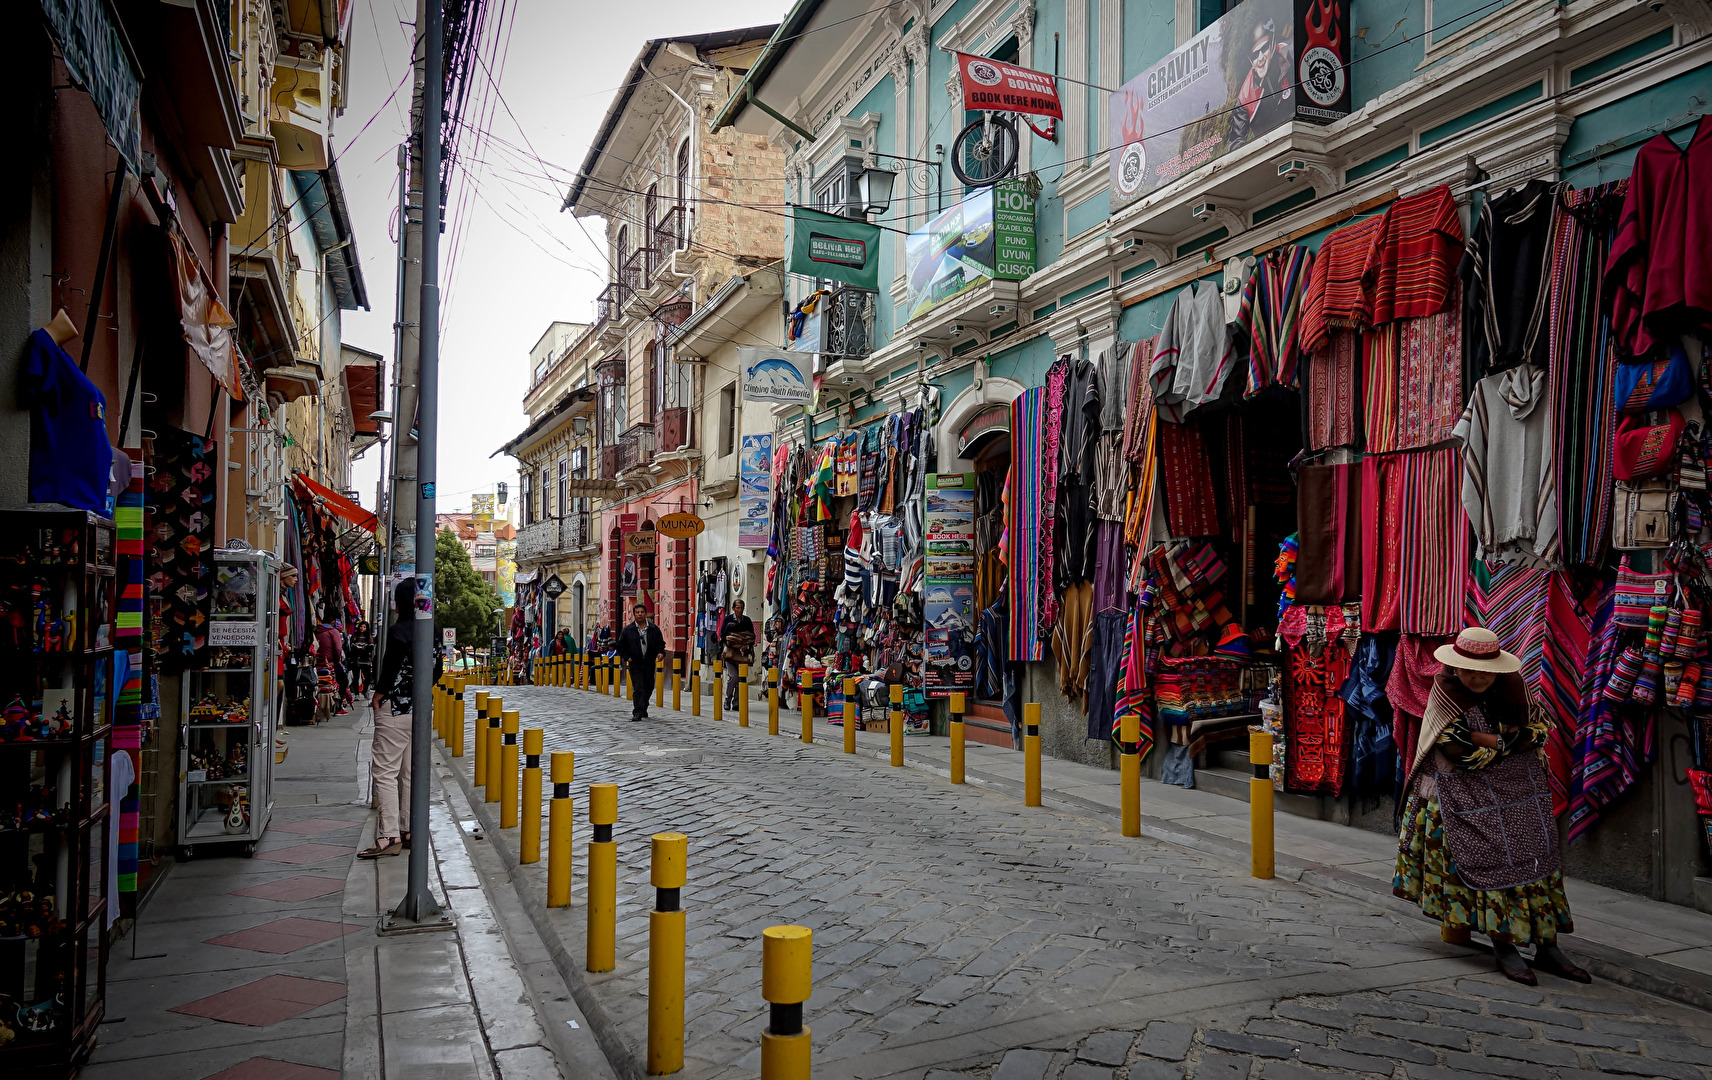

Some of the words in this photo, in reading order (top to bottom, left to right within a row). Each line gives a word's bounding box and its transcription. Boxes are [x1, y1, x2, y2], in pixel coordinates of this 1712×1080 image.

[1147, 34, 1210, 99] GRAVITY
[1002, 67, 1050, 85] GRAVITY
[1007, 77, 1055, 97] BOLIVIA
[1148, 91, 1169, 110] ASSISTED
[1168, 77, 1192, 98] MOUNTAIN
[1192, 65, 1209, 82] BIKING
[971, 92, 1000, 103] BOOK
[1003, 94, 1028, 107] HERE
[1030, 98, 1058, 112] NOW!
[1155, 153, 1182, 176] GALERIA
[1183, 132, 1223, 161] ARTESANAL
[997, 191, 1035, 211] HOP
[997, 223, 1010, 231] ISLA
[1011, 224, 1022, 232] DEL
[1023, 225, 1034, 233] SOL
[812, 241, 843, 252] BOLIVIA
[844, 244, 862, 254] HOP
[1005, 236, 1028, 246] PUNO
[1002, 249, 1031, 260] UYUNI
[997, 263, 1035, 276] CUSCO
[743, 384, 770, 394] Climbing
[770, 386, 787, 396] South
[973, 408, 1009, 430] GRAVITY
[661, 520, 701, 532] MUNAY
